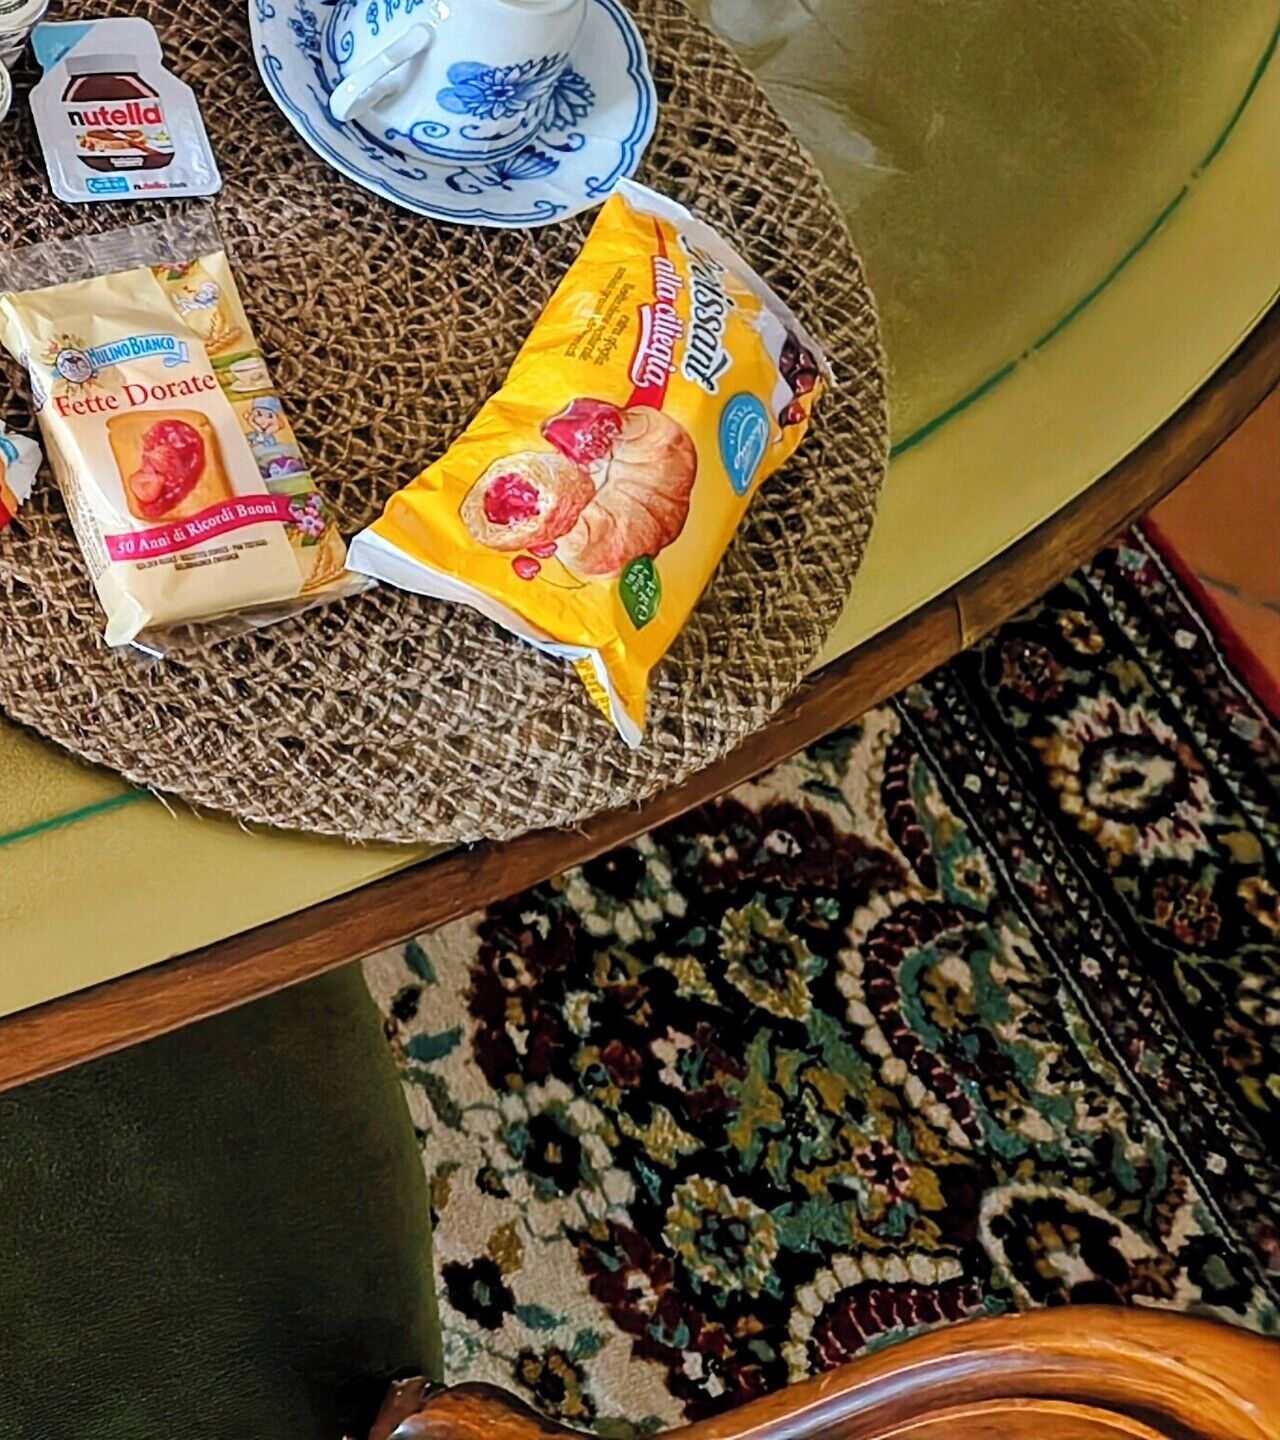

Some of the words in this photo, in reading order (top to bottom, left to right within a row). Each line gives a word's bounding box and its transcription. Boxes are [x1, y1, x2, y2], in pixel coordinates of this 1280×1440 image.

[67, 102, 163, 126] nutella
[653, 255, 683, 301] alla
[86, 343, 132, 367] MULINO
[128, 336, 175, 357] BIANCO
[646, 302, 683, 387] ciliegia
[54, 394, 120, 418] Fette
[122, 373, 217, 408] Dorate
[139, 533, 171, 552] Anni
[173, 527, 186, 543] di
[185, 506, 234, 538] Ricordi
[236, 501, 278, 518] Buoni
